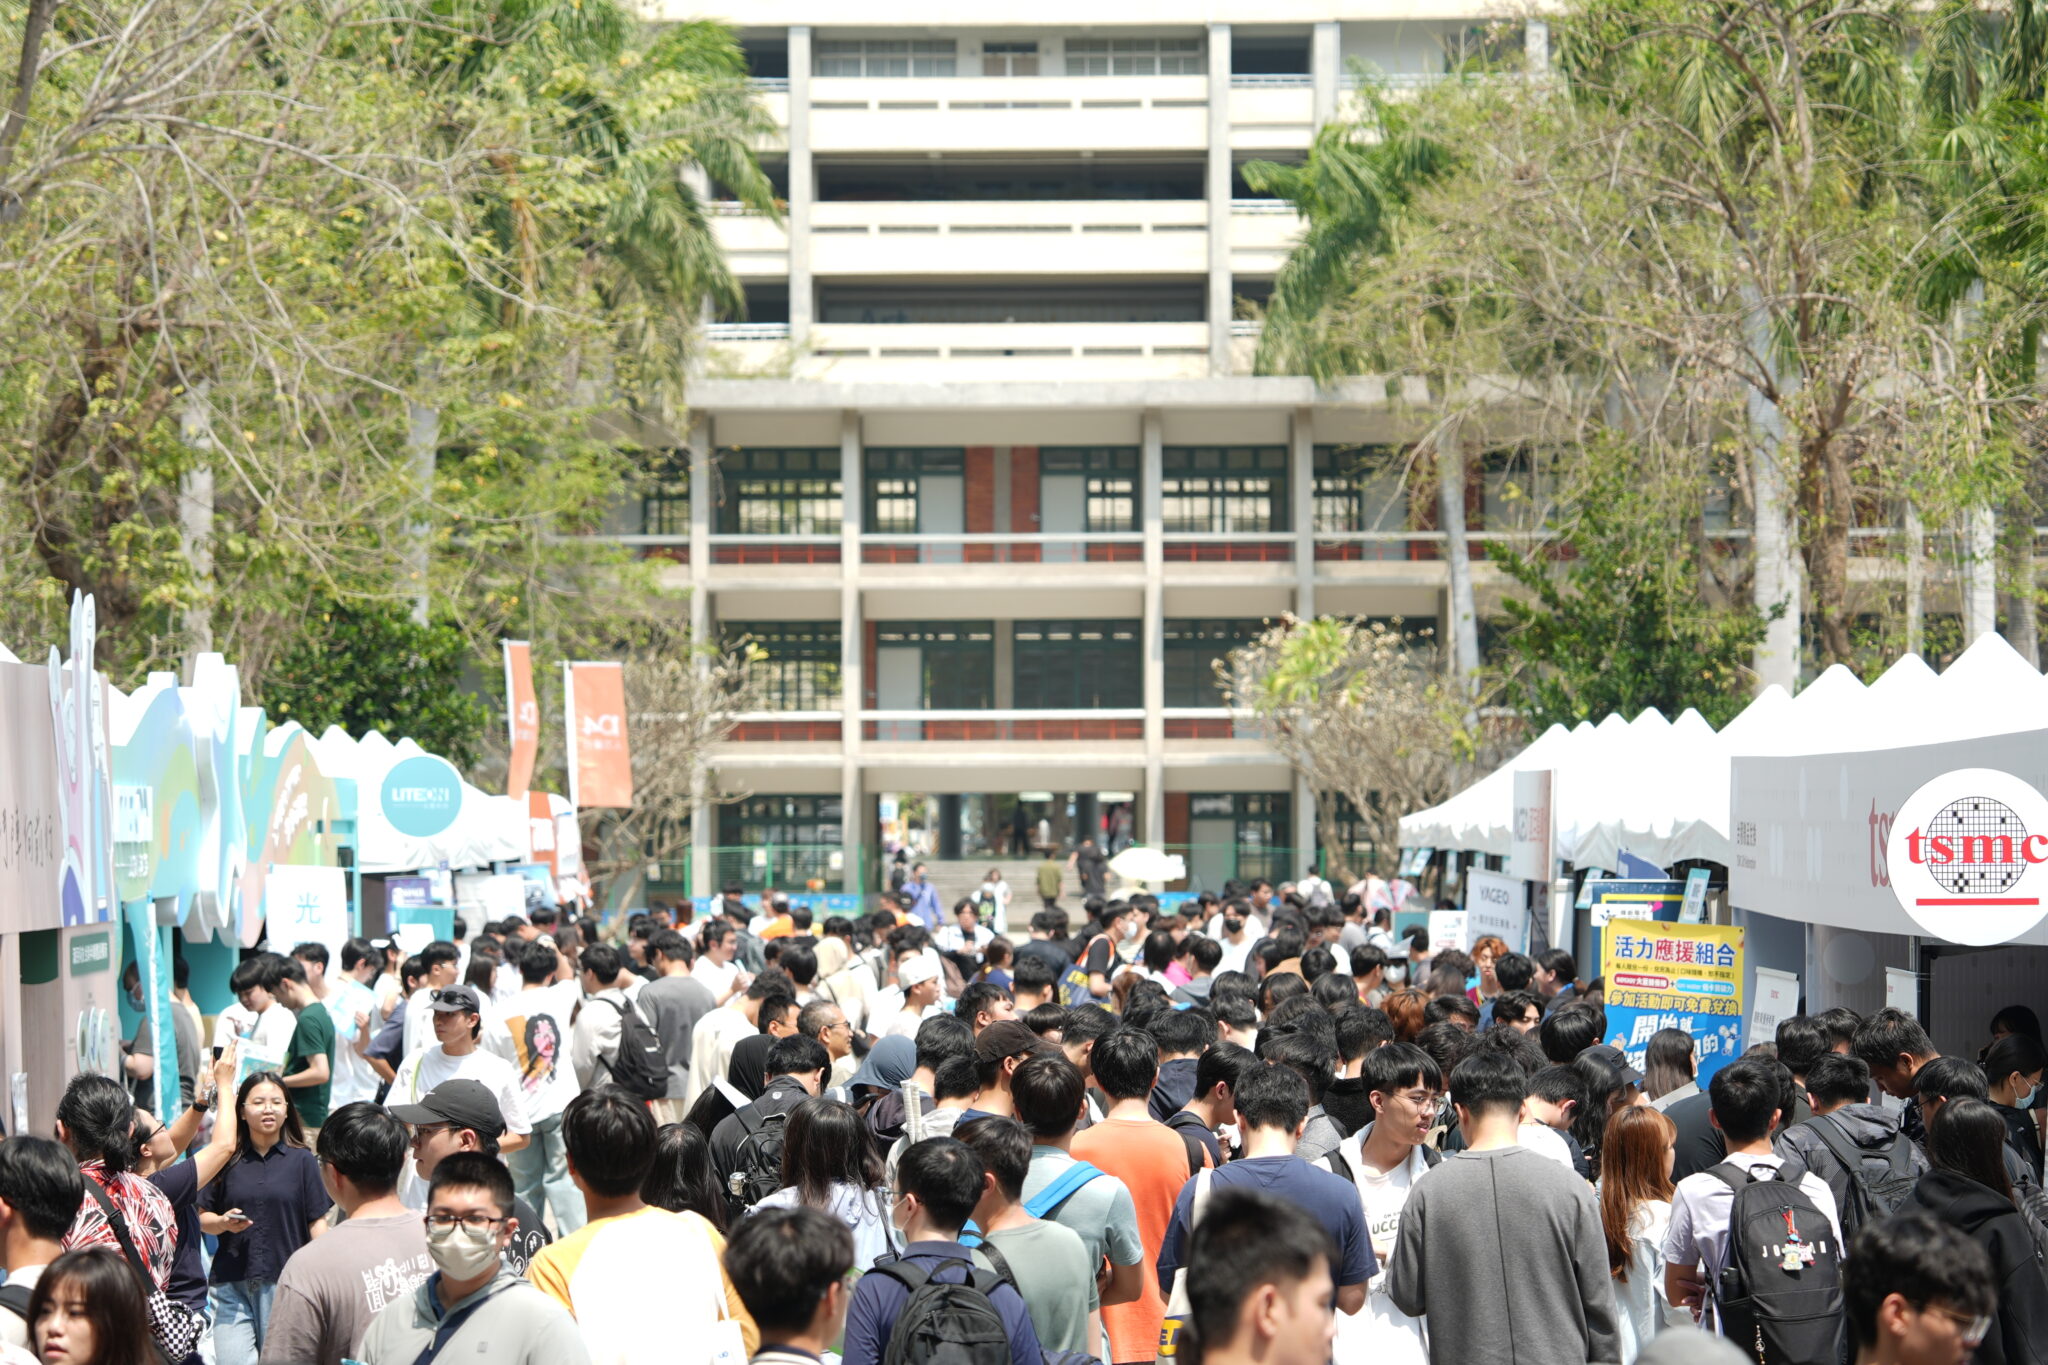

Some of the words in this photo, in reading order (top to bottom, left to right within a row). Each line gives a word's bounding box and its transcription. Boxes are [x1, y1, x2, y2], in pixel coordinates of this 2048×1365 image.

[1904, 826, 2048, 864] tsmc
[296, 892, 321, 924] 光
[1615, 936, 1735, 967] 活力應援組合
